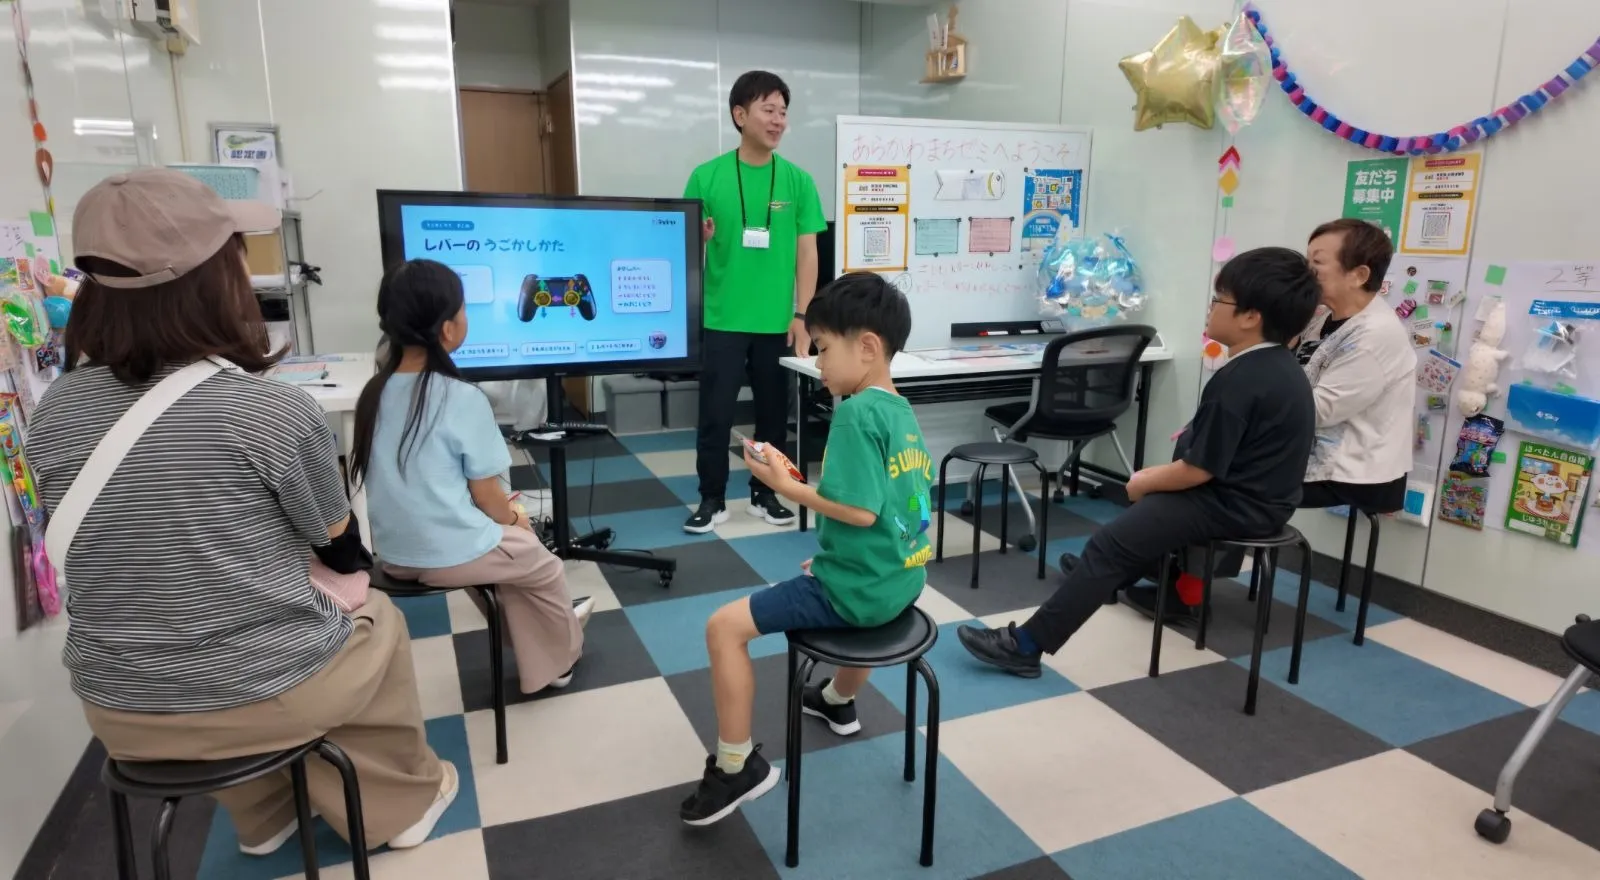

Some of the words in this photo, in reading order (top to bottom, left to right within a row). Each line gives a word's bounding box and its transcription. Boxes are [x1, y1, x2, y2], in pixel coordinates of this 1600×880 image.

[1355, 168, 1398, 186] 友だち
[1353, 187, 1396, 204] 募集中
[424, 237, 480, 252] レバーの
[484, 237, 566, 252] うごかしかた
